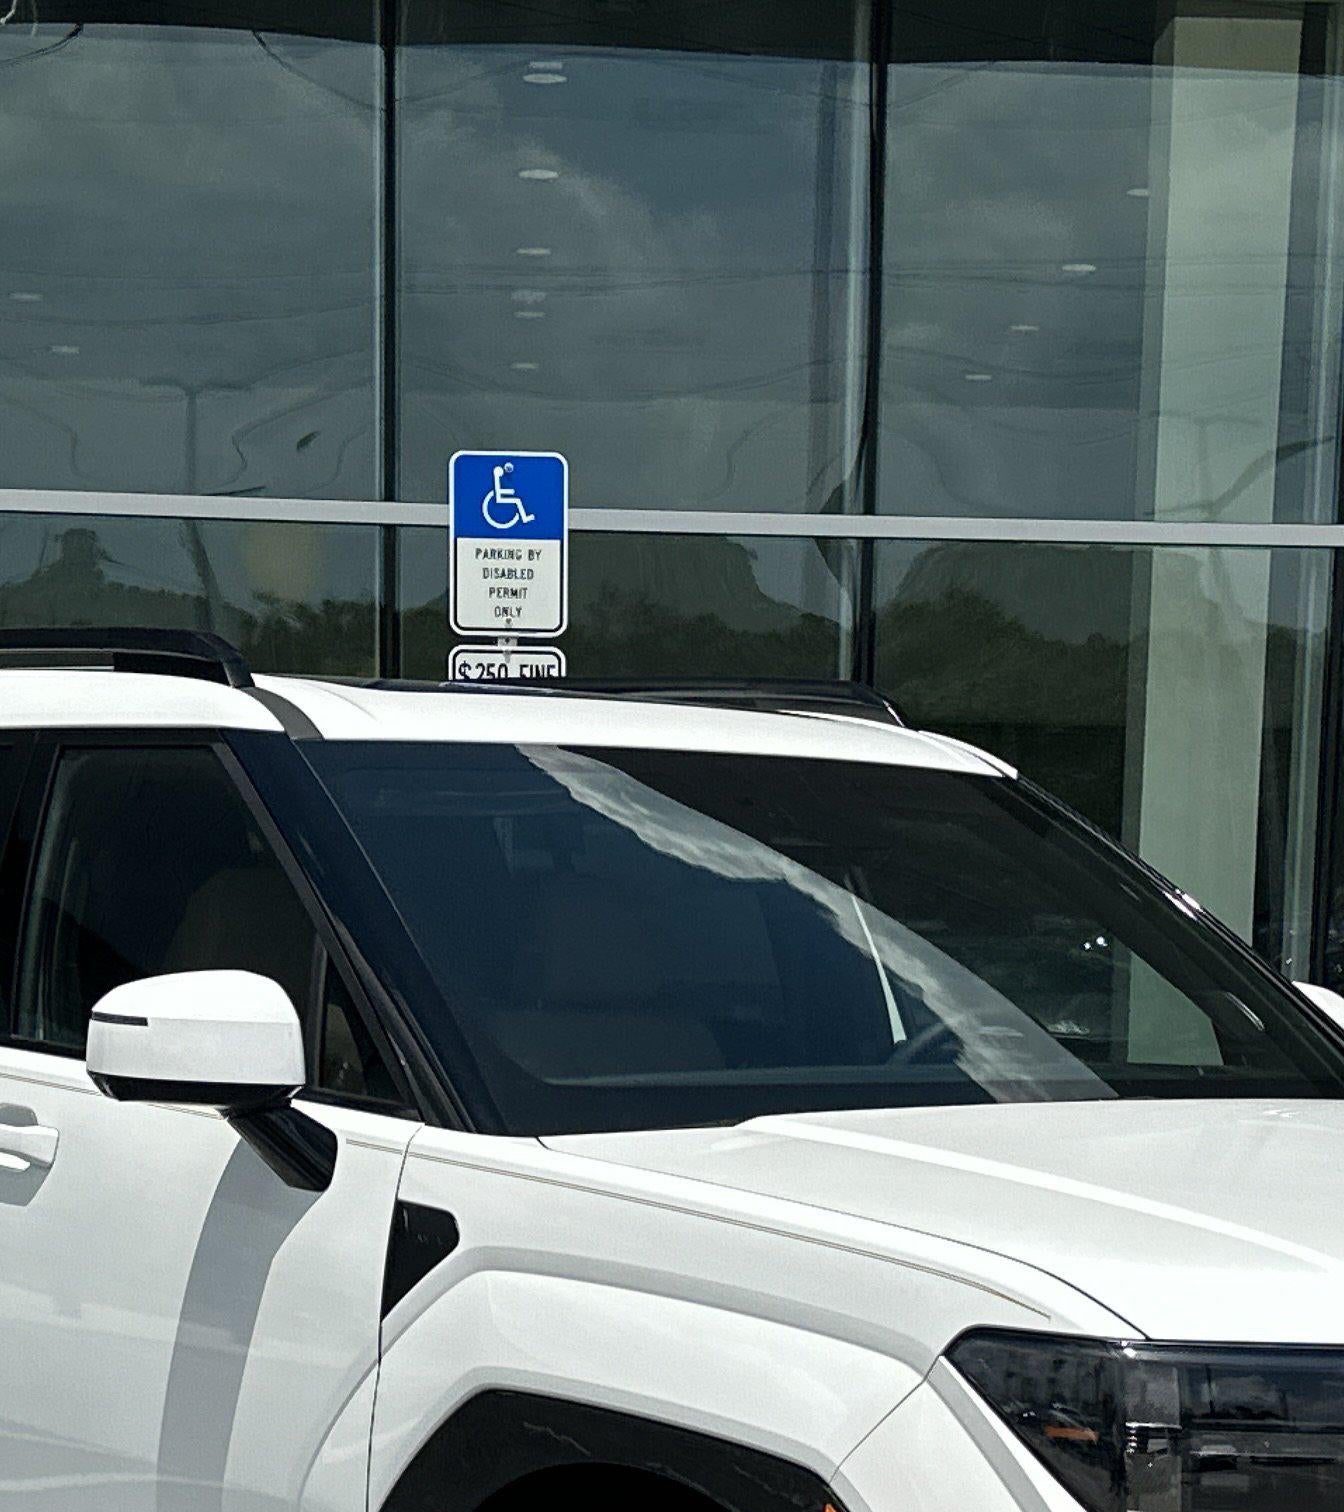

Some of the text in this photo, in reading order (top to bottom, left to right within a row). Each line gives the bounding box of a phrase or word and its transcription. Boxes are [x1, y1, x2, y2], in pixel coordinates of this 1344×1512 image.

[475, 548, 542, 561] PARKING BY
[482, 567, 534, 580] DISABLED
[489, 587, 528, 599] PERMIT
[494, 606, 522, 618] ONLY
[458, 661, 509, 680] $250
